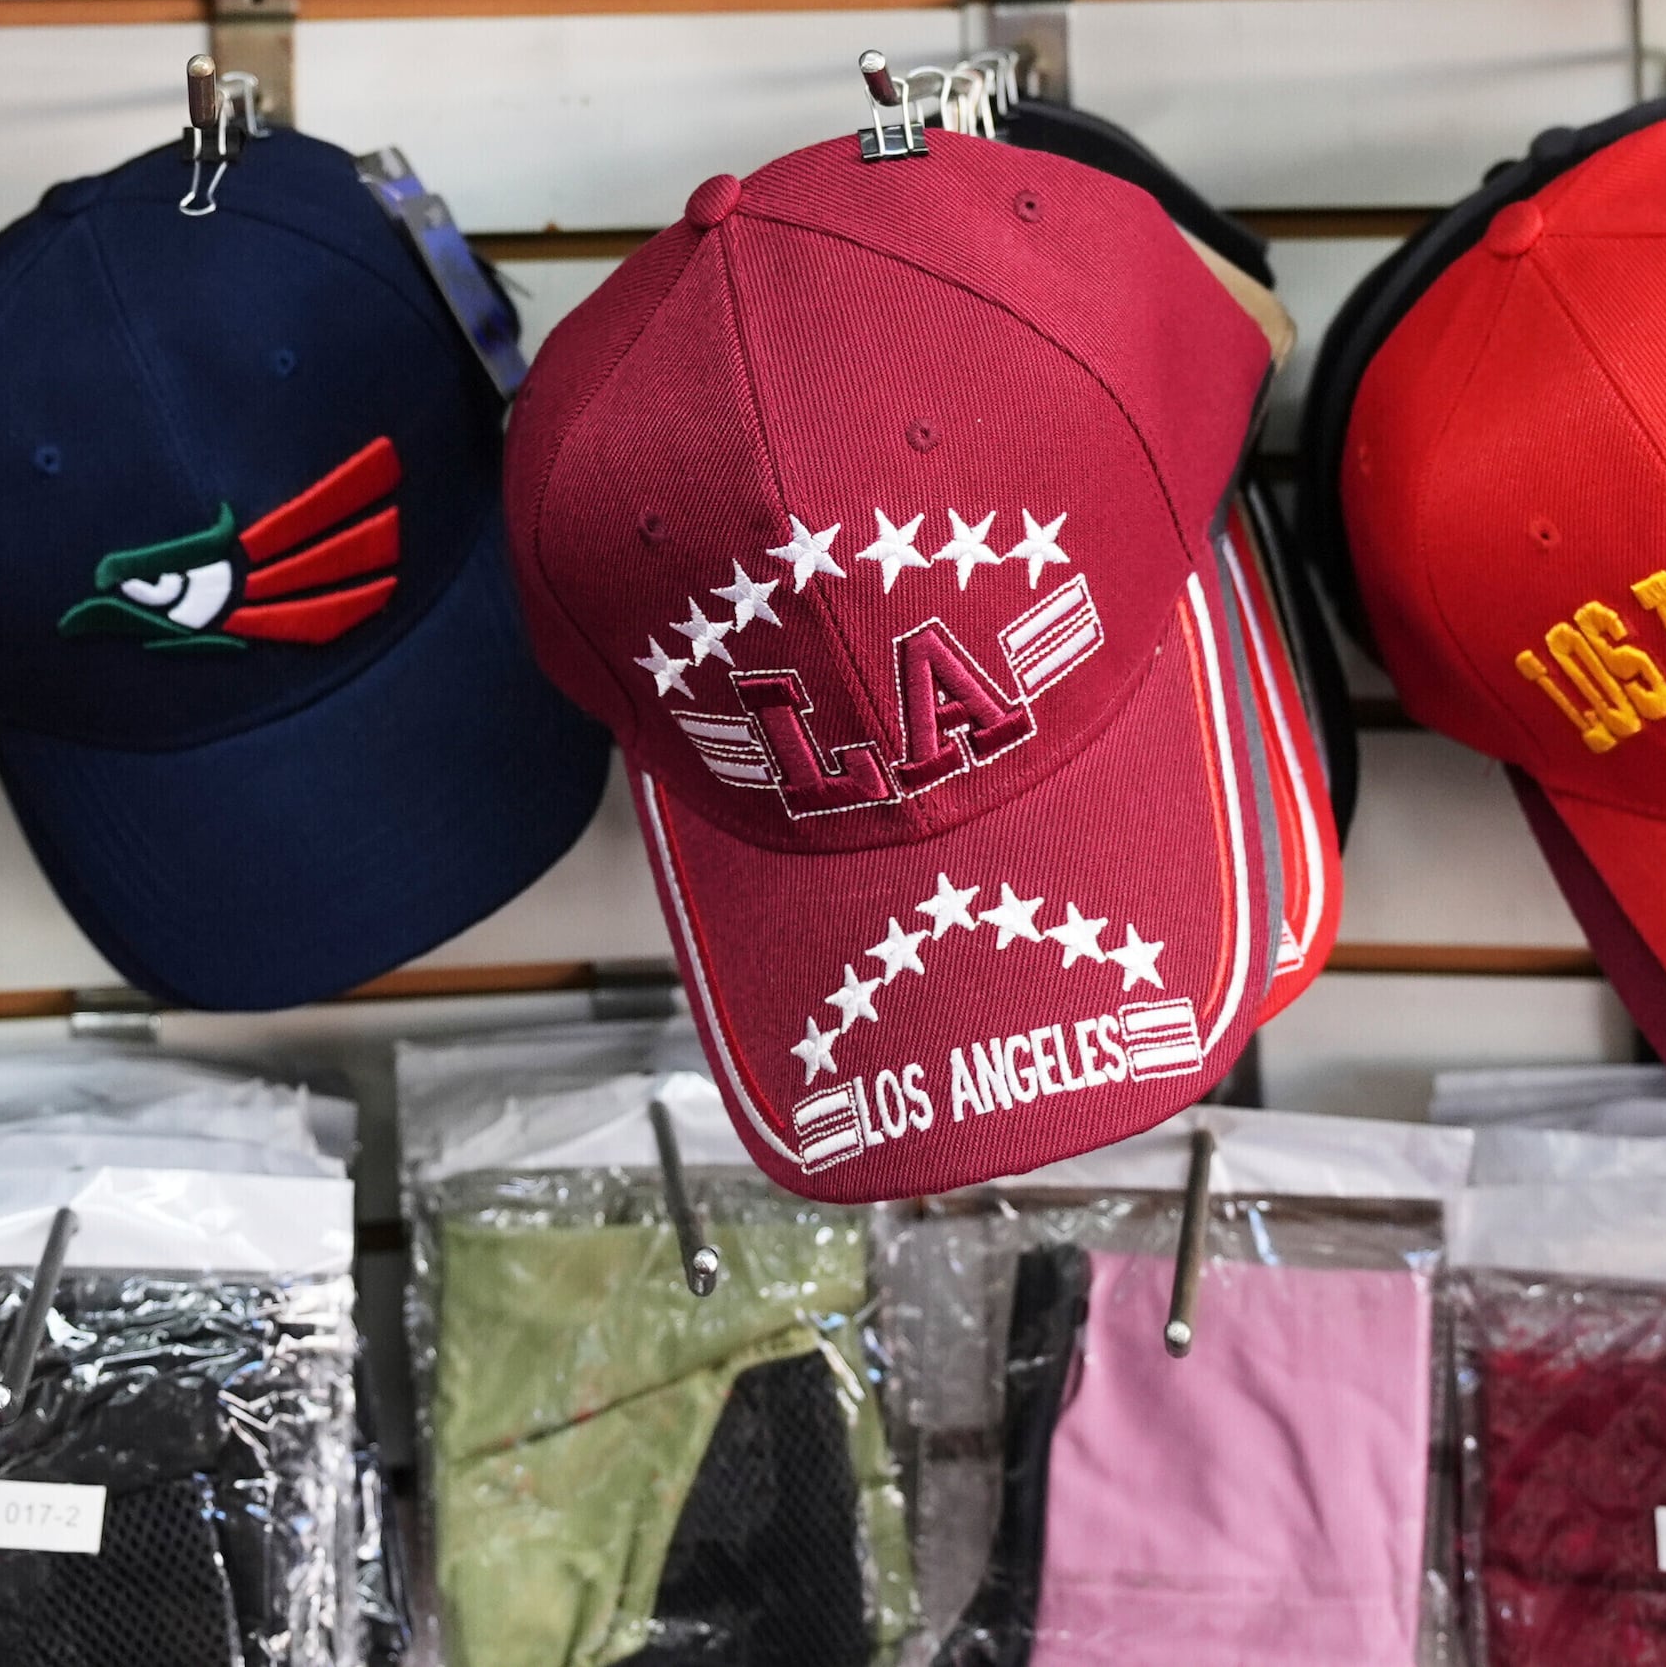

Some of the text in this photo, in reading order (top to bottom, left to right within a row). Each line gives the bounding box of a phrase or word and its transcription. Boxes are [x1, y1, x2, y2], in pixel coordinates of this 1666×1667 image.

[730, 616, 1038, 820] LA
[852, 1015, 1129, 1147] LOS ANGELES
[4, 1501, 81, 1528] 017-2
